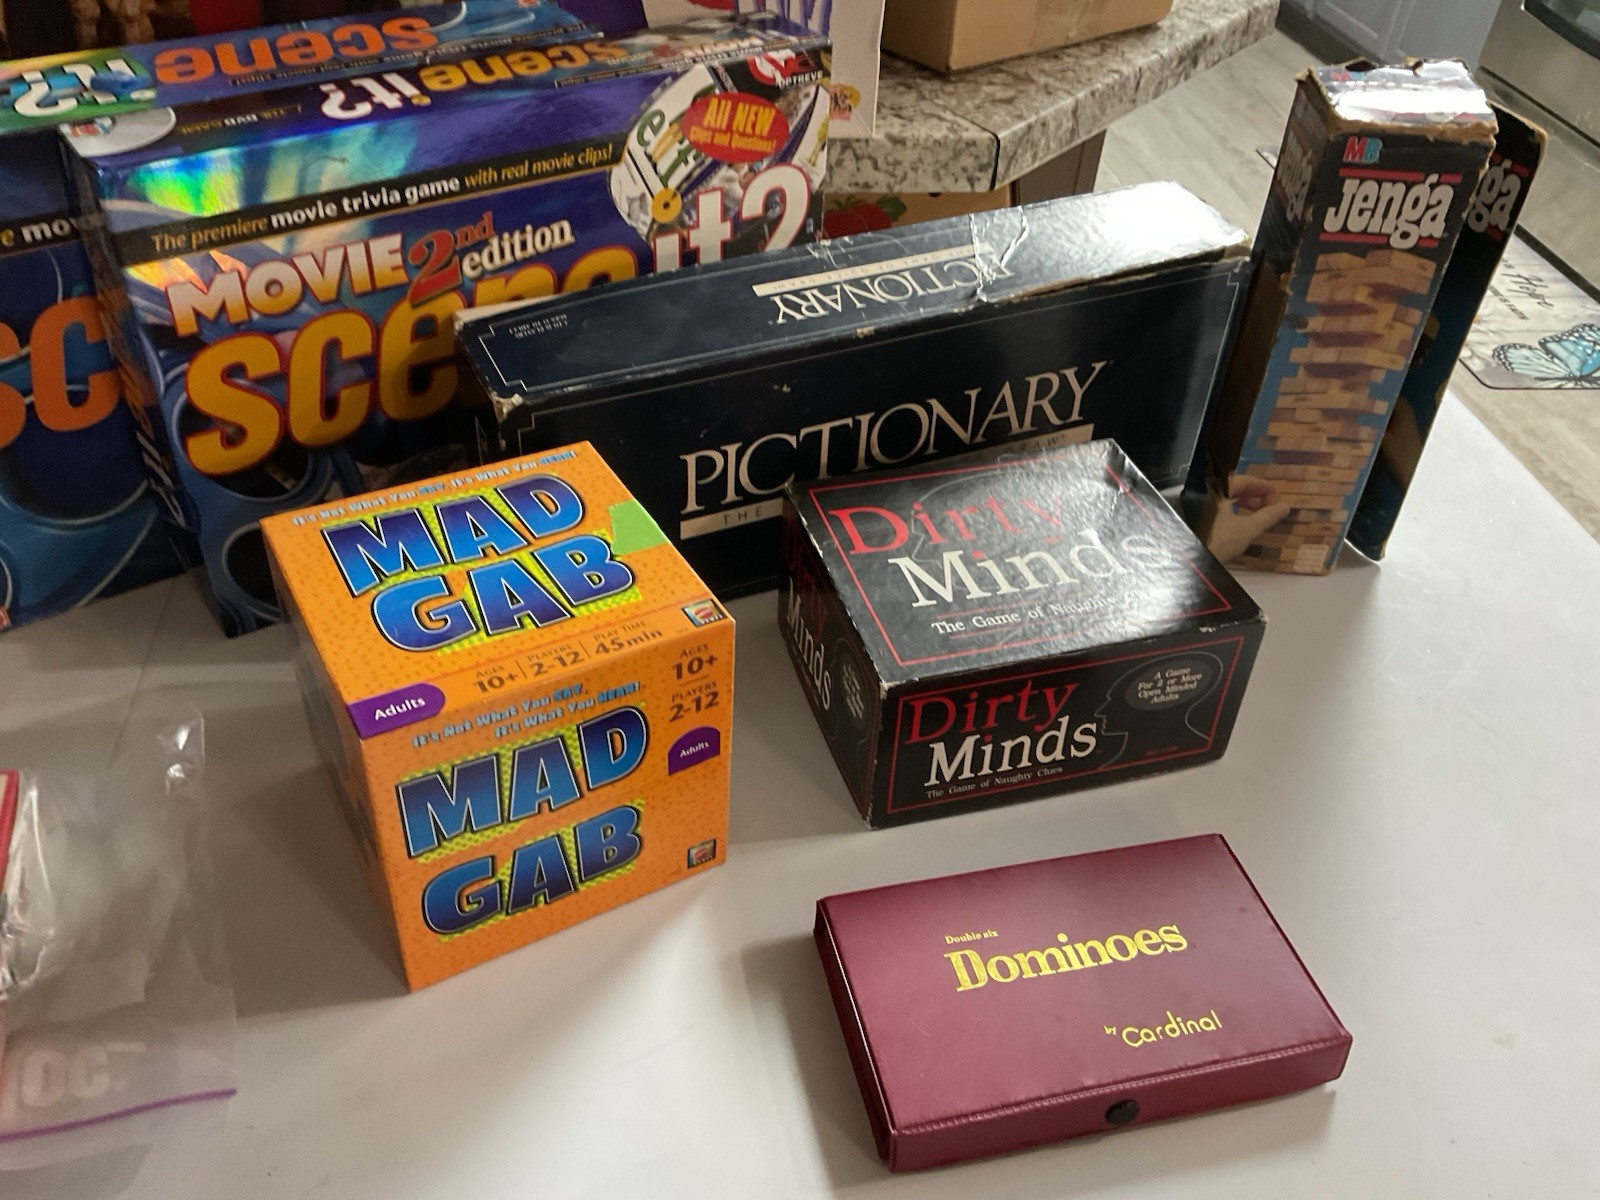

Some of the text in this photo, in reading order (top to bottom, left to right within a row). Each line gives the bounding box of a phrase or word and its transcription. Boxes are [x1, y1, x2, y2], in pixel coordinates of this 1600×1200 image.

[155, 16, 438, 85] scene
[421, 40, 628, 92] scene
[320, 71, 433, 120] it?
[703, 95, 777, 137] All NEW
[1343, 136, 1383, 164] MB
[152, 145, 614, 252] The premiere movie trivia game with real movie clips!
[1323, 172, 1456, 250] Jenga
[460, 216, 577, 280] edition
[165, 232, 410, 338] MOVIE
[680, 361, 1107, 515] PICTIONARY
[319, 506, 346, 521] Not
[348, 495, 386, 516] What
[390, 488, 416, 502] You
[475, 465, 510, 482] What
[513, 460, 538, 473] You
[722, 505, 763, 525] THE
[320, 473, 586, 598] MAD
[828, 490, 1065, 557] Dirty
[369, 534, 637, 653] GAB
[887, 530, 1176, 610] Minds
[592, 628, 619, 642] PLAY
[931, 620, 966, 636] The
[971, 612, 1022, 629] Game
[1029, 605, 1046, 620] of
[473, 672, 519, 695] 10+
[529, 651, 585, 677] 2-12
[671, 654, 718, 681] 10+
[1165, 667, 1191, 678] Game
[1181, 672, 1203, 684] More
[374, 695, 427, 721] Adults
[668, 691, 720, 723] 2-12
[905, 678, 1080, 745] Dirty
[1137, 680, 1198, 700] Open Minded
[412, 732, 440, 749] It's
[443, 720, 472, 739] Not
[475, 703, 519, 727] What
[521, 694, 550, 713] You
[495, 720, 522, 739] It's
[523, 707, 565, 729] What
[567, 696, 596, 714] You
[679, 739, 710, 759] Adults
[922, 714, 1099, 788] Minds
[394, 705, 650, 860] MAD
[926, 765, 1064, 800] The Game of Naughty Clues
[421, 804, 644, 936] GAB
[943, 924, 1188, 993] Dominoes
[944, 931, 982, 945] Double
[1121, 1009, 1223, 1048] Cardinal
